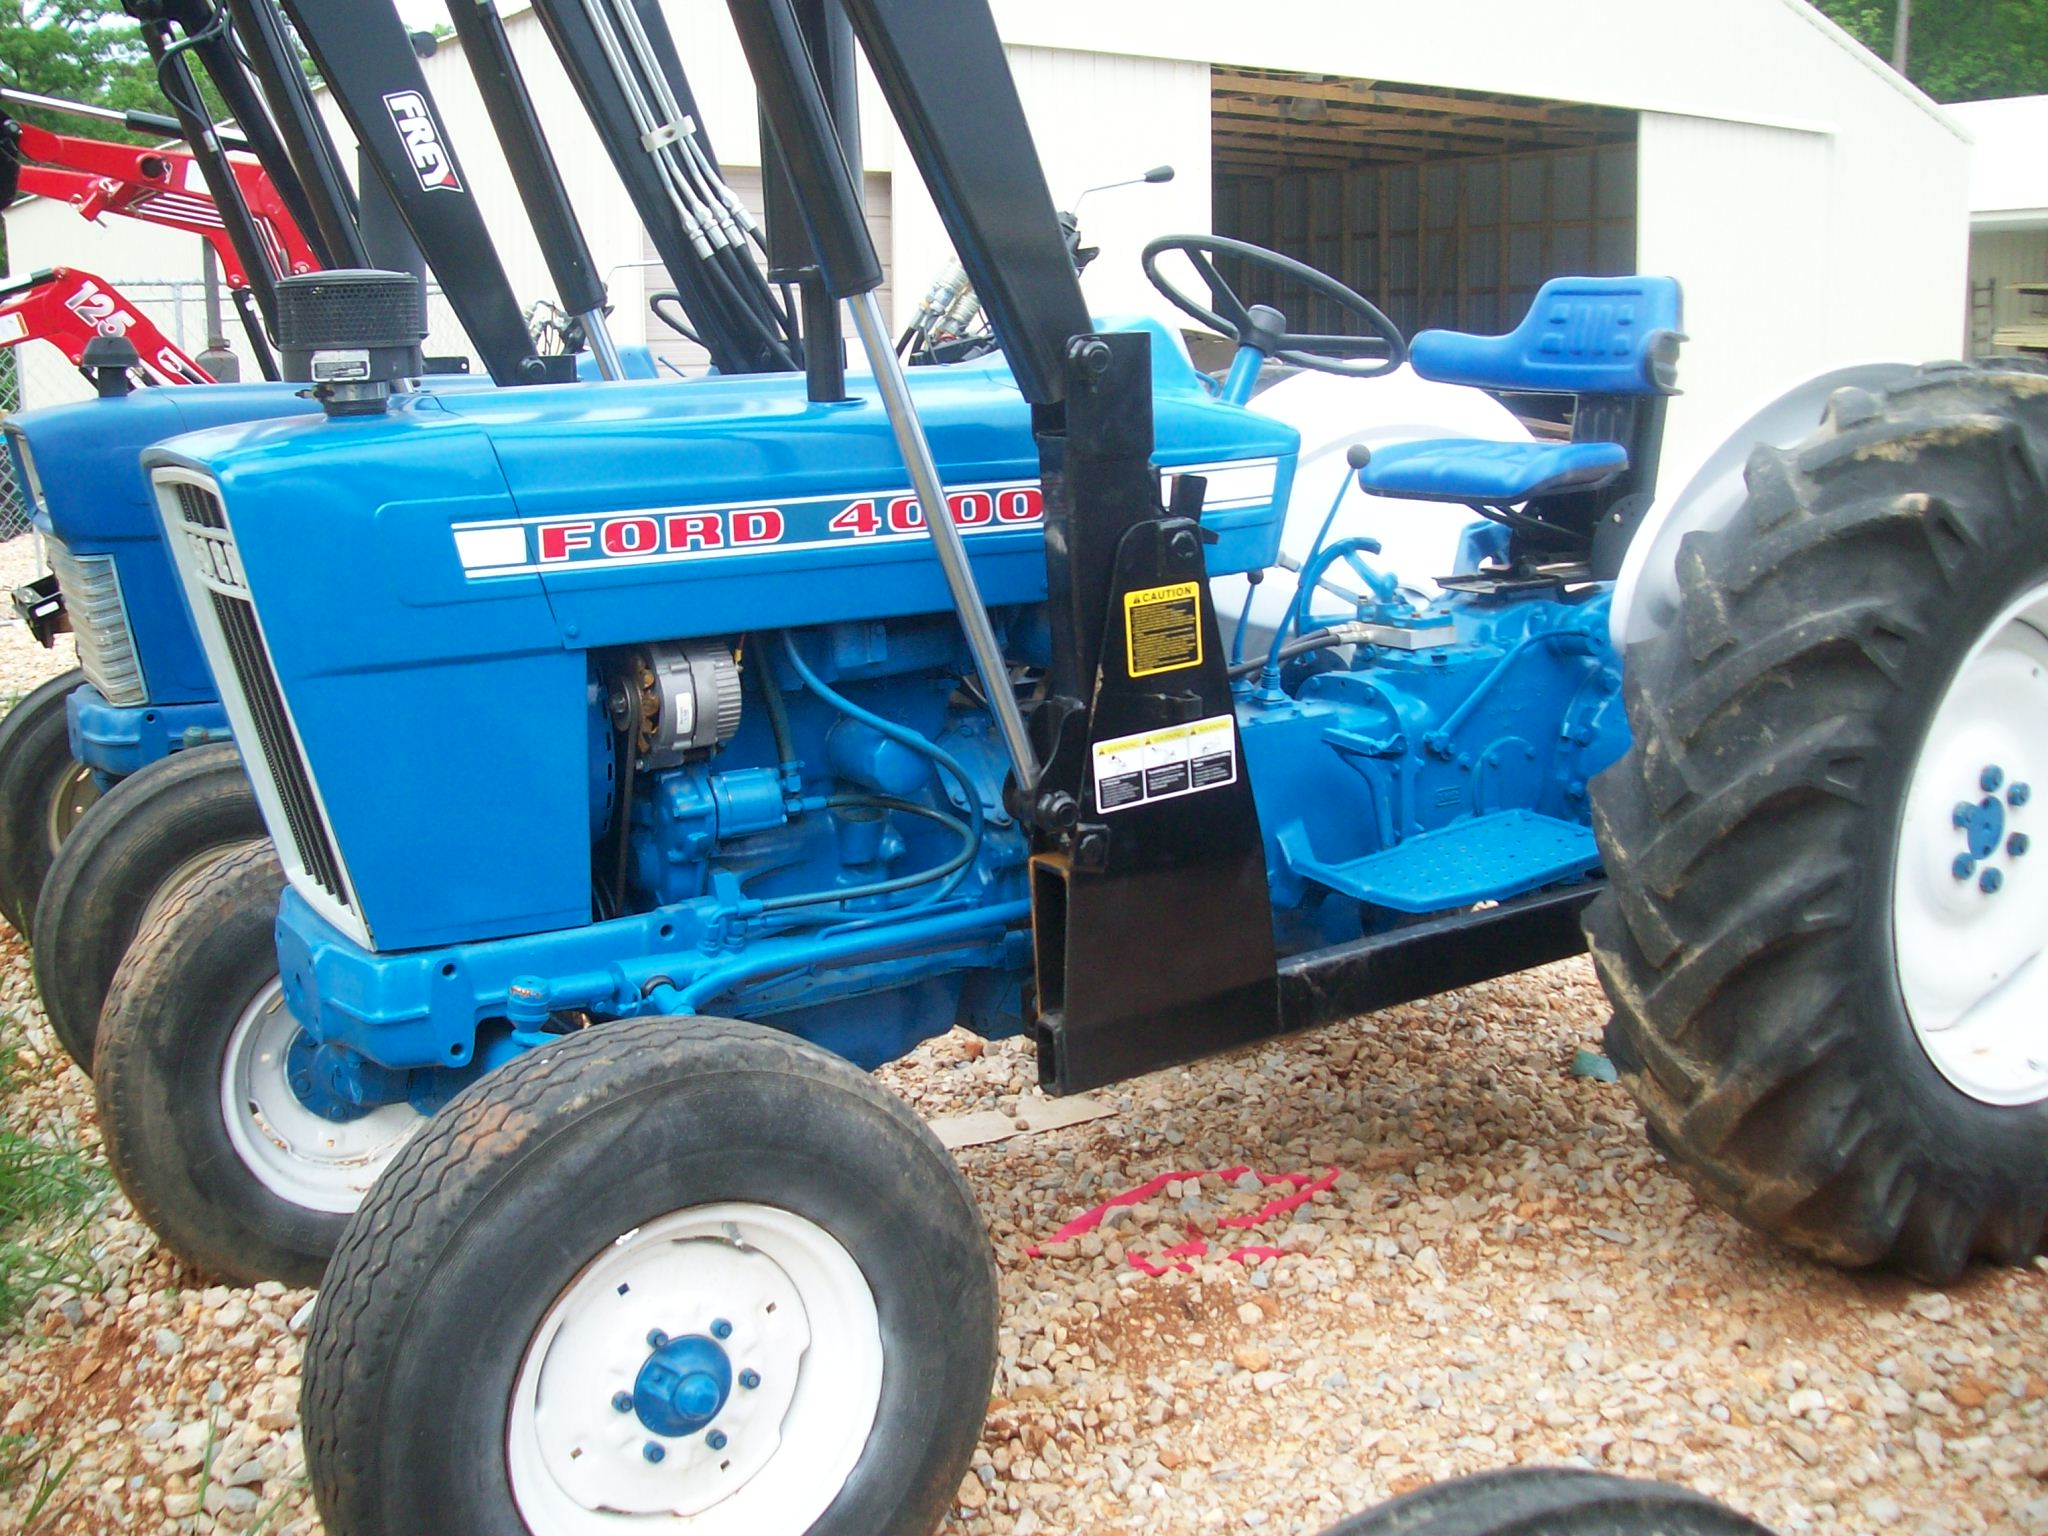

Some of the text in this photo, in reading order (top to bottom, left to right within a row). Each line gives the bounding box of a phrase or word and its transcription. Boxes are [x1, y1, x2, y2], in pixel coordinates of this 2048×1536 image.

[388, 94, 458, 187] FREY
[64, 280, 137, 337] 125
[537, 487, 1044, 563] FORD 4000
[1142, 586, 1192, 602] CAUTION
